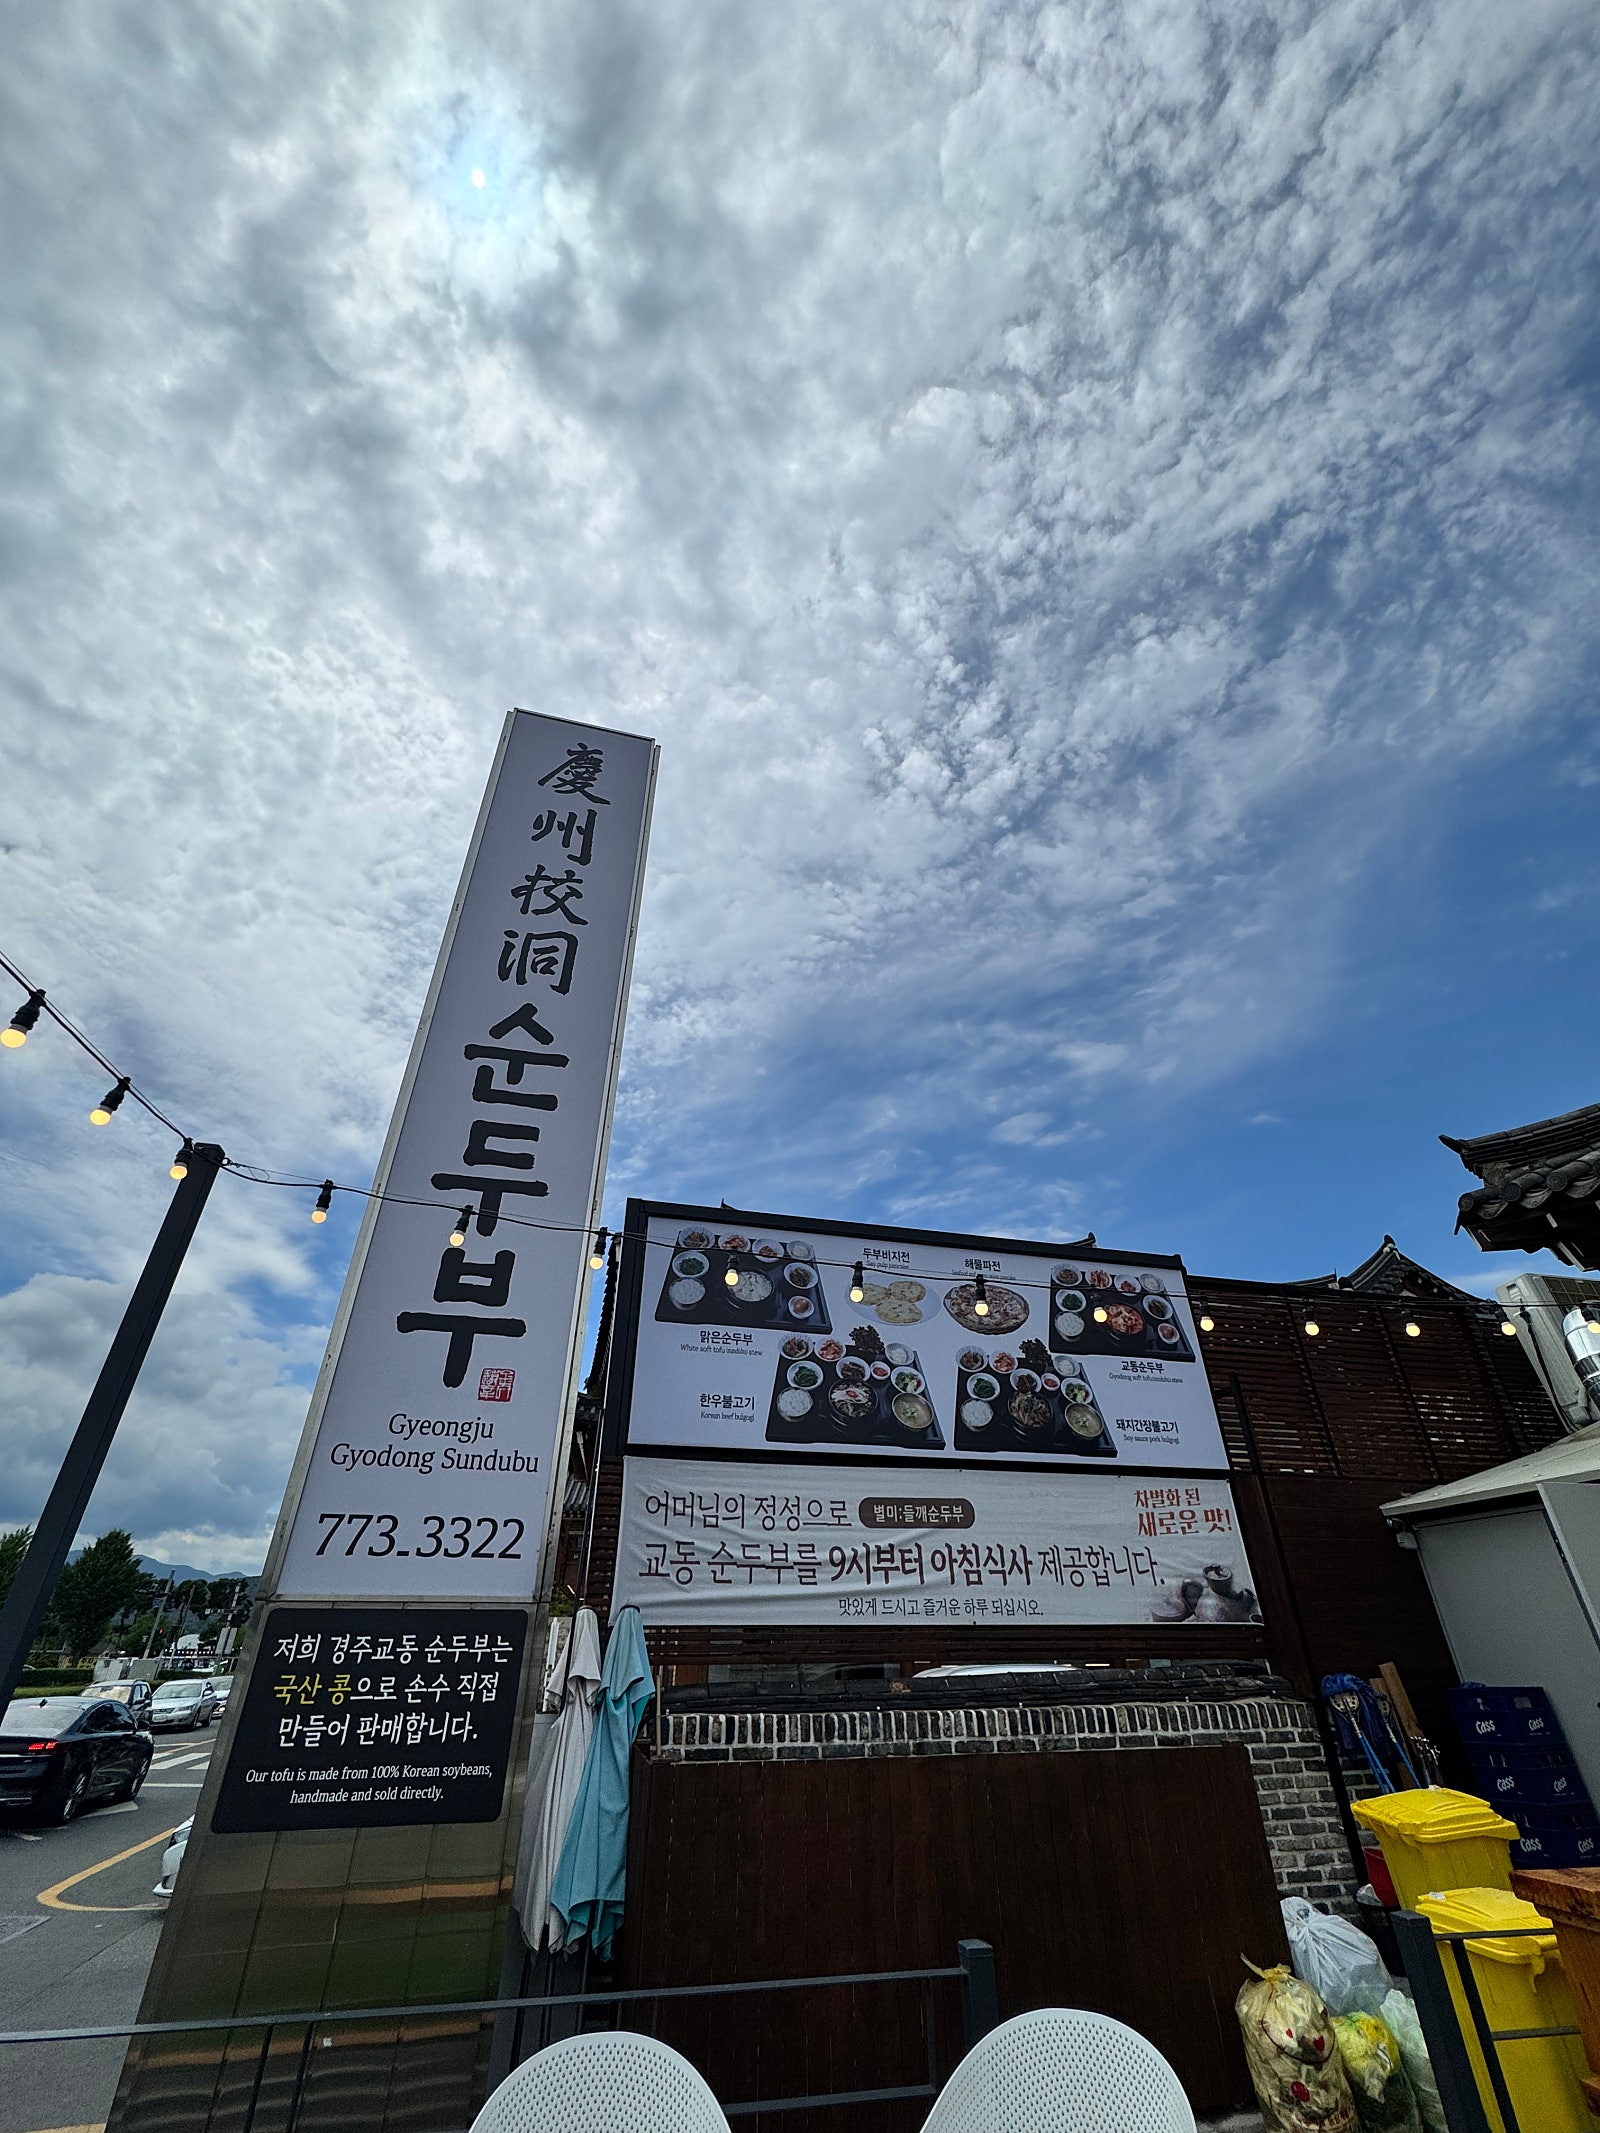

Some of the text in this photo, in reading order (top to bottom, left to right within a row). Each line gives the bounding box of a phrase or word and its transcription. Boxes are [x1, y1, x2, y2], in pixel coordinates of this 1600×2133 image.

[397, 1003, 570, 1388] 순두부
[863, 1248, 910, 1263] 두부비지전
[964, 1259, 1001, 1272] 해물파전
[700, 1330, 753, 1346] 맑은순두부
[1121, 1361, 1164, 1374] 교동순두부
[700, 1394, 755, 1410] 한우불고기
[389, 1413, 494, 1444] Gyeongju
[1116, 1419, 1179, 1434] 돼지간장불고기
[331, 1443, 539, 1474] Gyodong Sundubu
[1134, 1488, 1200, 1508] 차별화 된
[646, 1490, 852, 1531] 어머님의 정성으로
[1138, 1508, 1232, 1537] 새로운 맛!
[639, 1541, 1165, 1588] 교동 순두부를 9시부터 아침식사 제공합니다.
[839, 1598, 1044, 1617] 맛있게 드시고 즐거운 하루 되십시오.
[274, 1633, 513, 1664] 저희 경주교동 순두부는
[274, 1671, 500, 1705] 국산 콩으로 손수 직접
[279, 1711, 478, 1747] 만들어 판매합니다.
[245, 1763, 493, 1783] Our tofu is made from 100% Korean soybeans,
[289, 1785, 444, 1804] handmade and sold directly.
